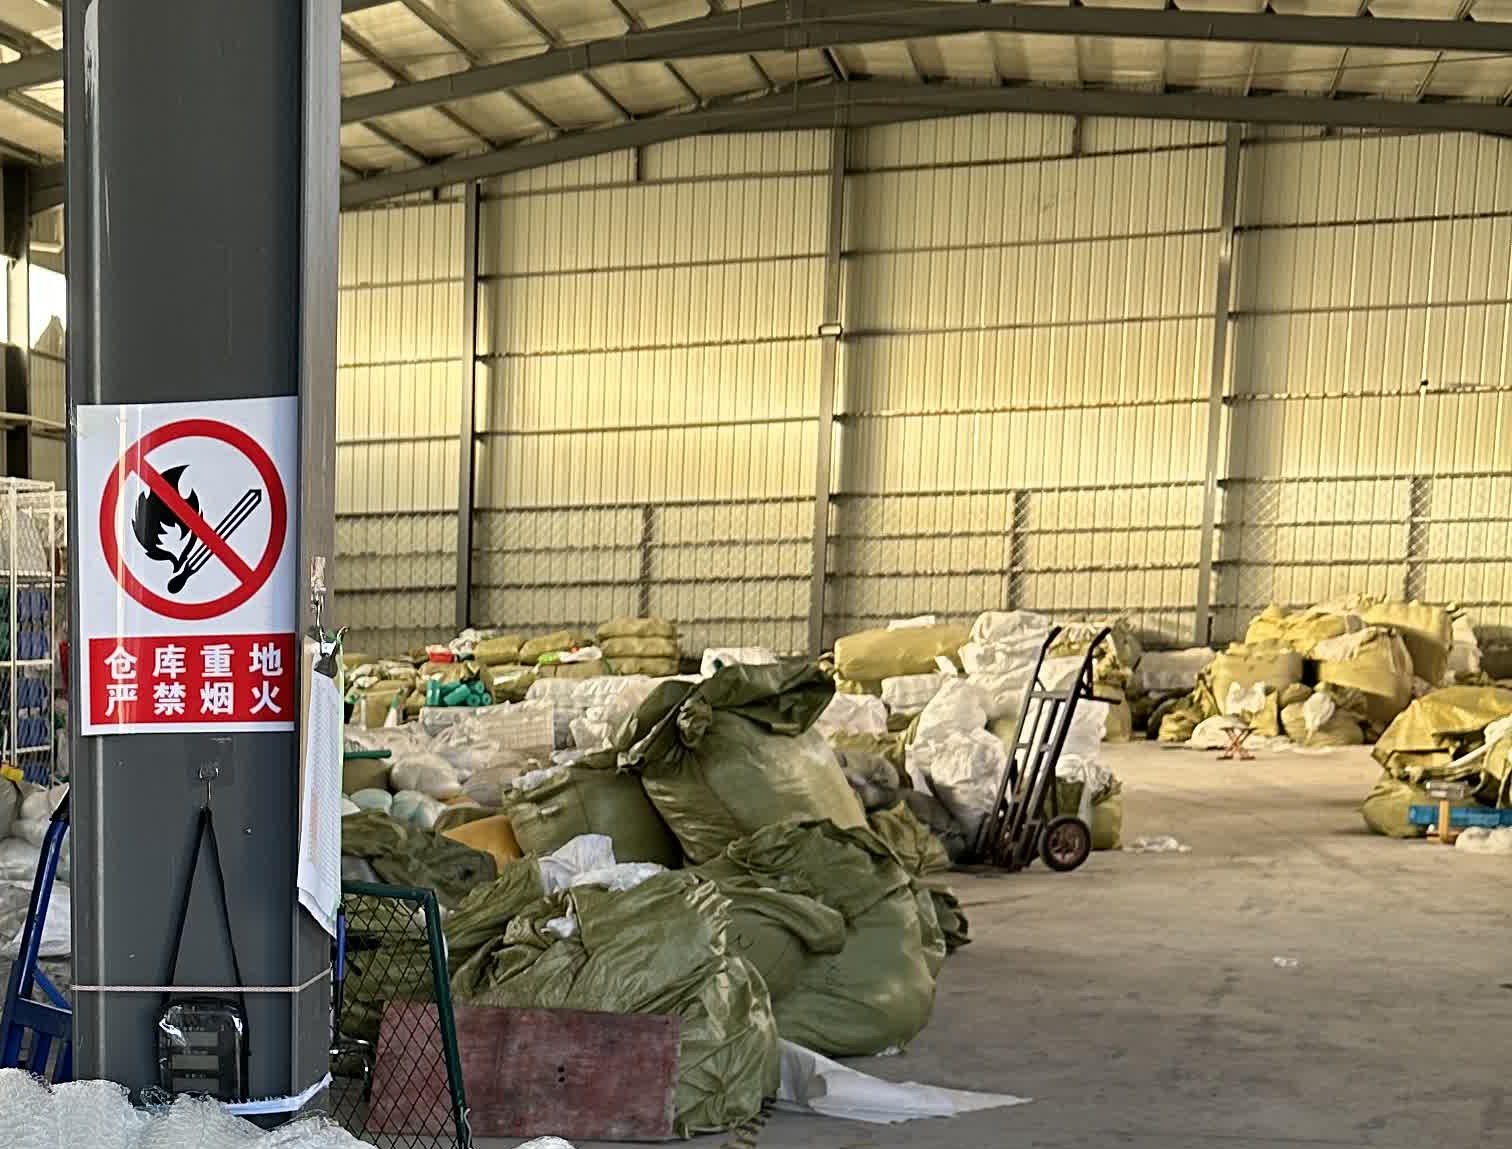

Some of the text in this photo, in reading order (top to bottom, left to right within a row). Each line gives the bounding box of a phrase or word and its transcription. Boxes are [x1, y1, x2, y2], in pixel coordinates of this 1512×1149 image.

[104, 642, 284, 680] 仓库重地
[104, 681, 282, 717] 严禁烟火
